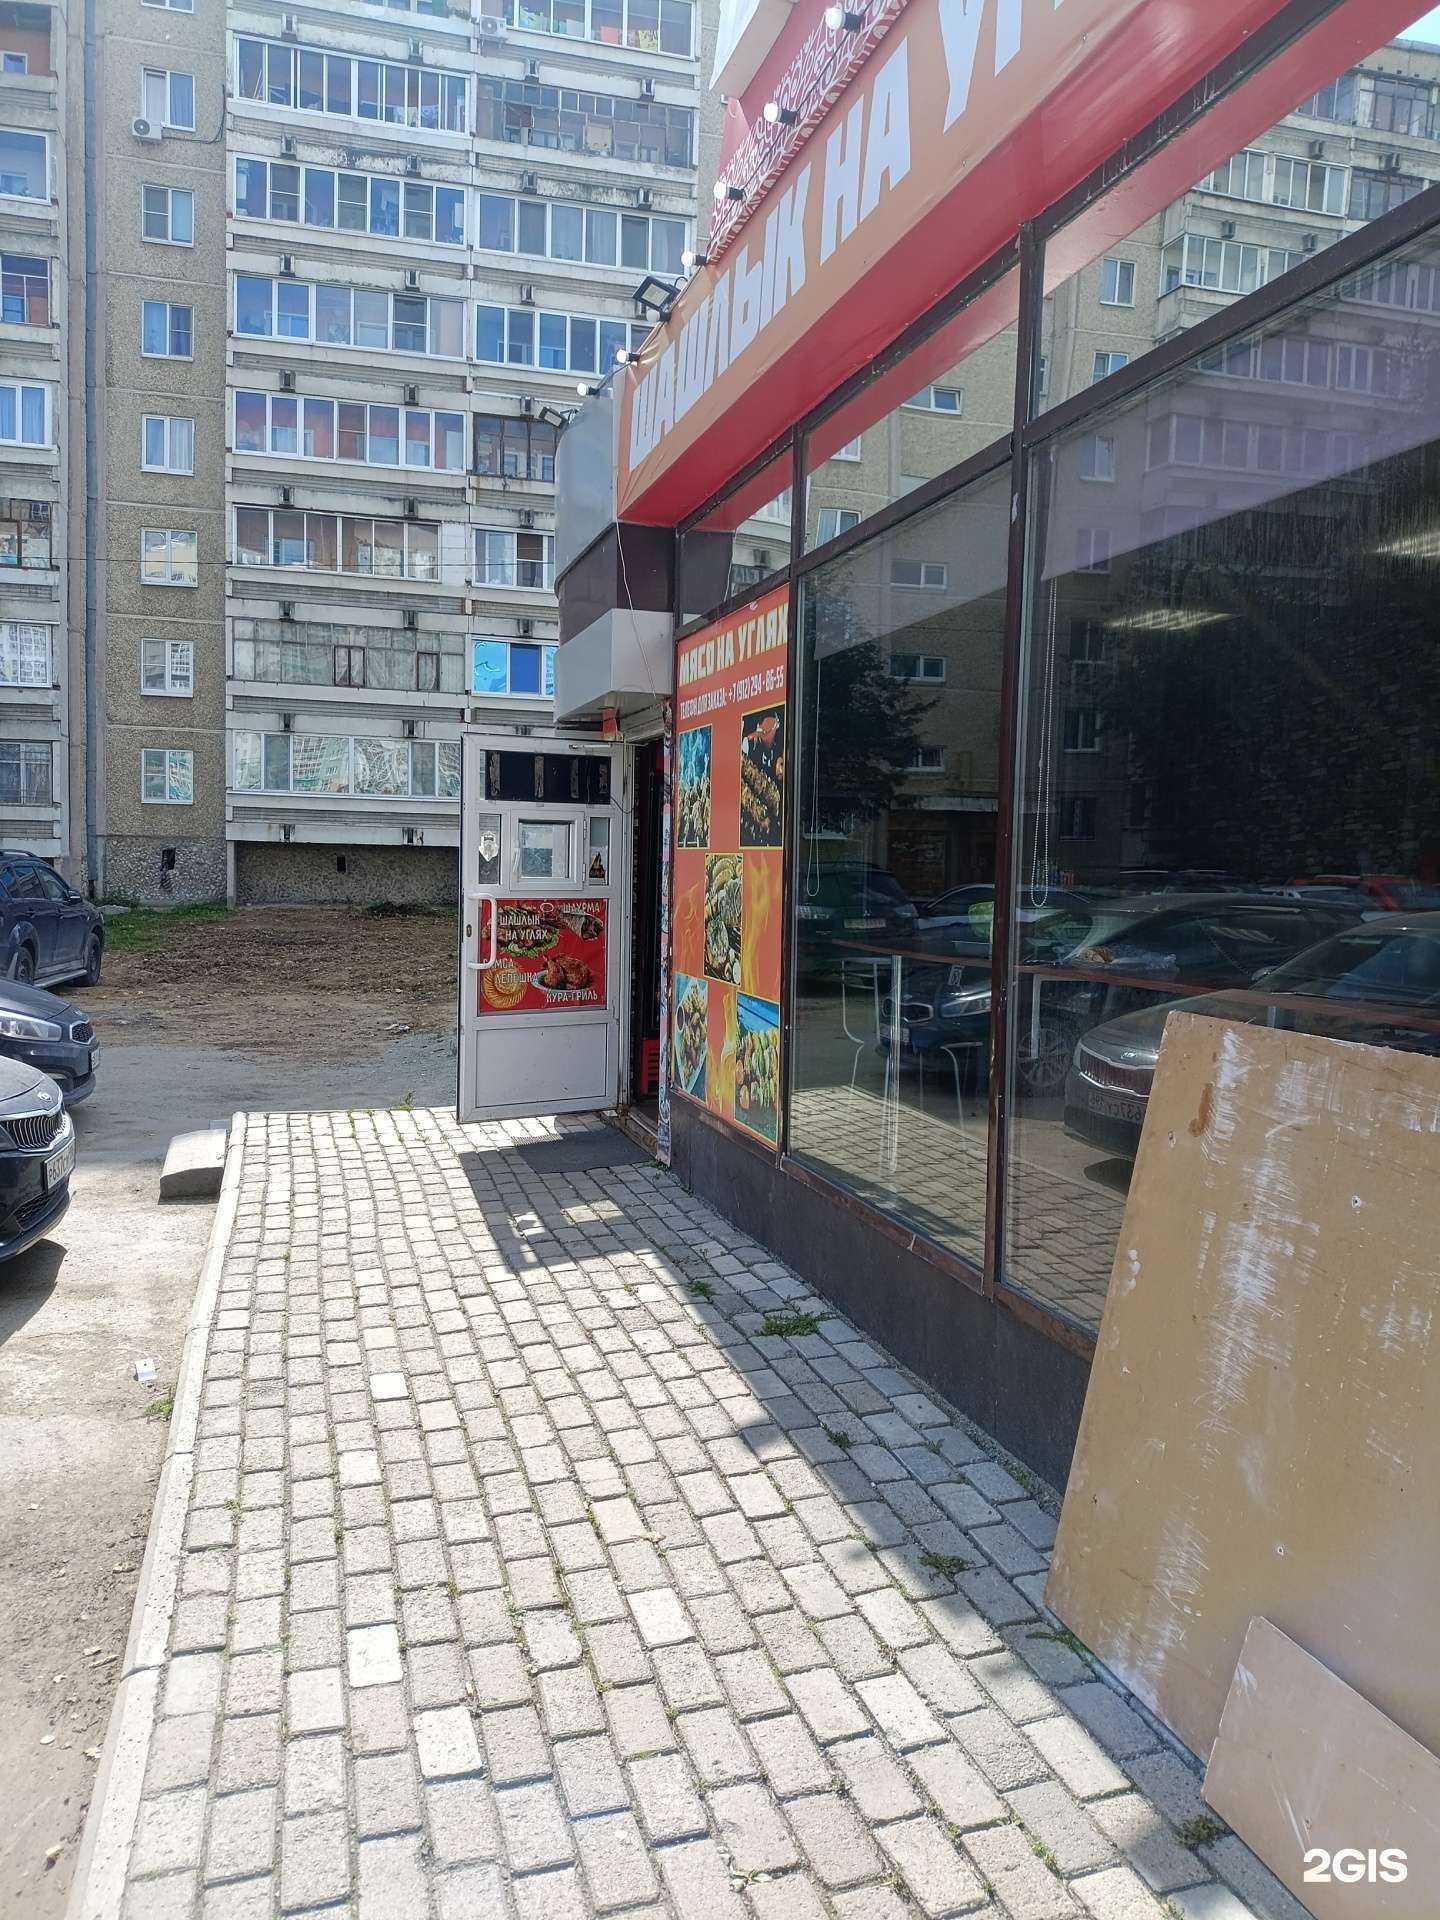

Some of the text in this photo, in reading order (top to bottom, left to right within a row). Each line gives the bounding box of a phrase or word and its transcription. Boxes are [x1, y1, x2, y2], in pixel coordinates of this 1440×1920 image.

[630, 37, 912, 472] ШАШЛЫК НА
[679, 602, 789, 688] МЯСО НА УГЛЯХ
[563, 901, 600, 914] ШАУРМА
[500, 914, 541, 926] ШАШЛЫК
[505, 928, 549, 940] НА УГЛЯХ
[483, 958, 515, 969] СМСА
